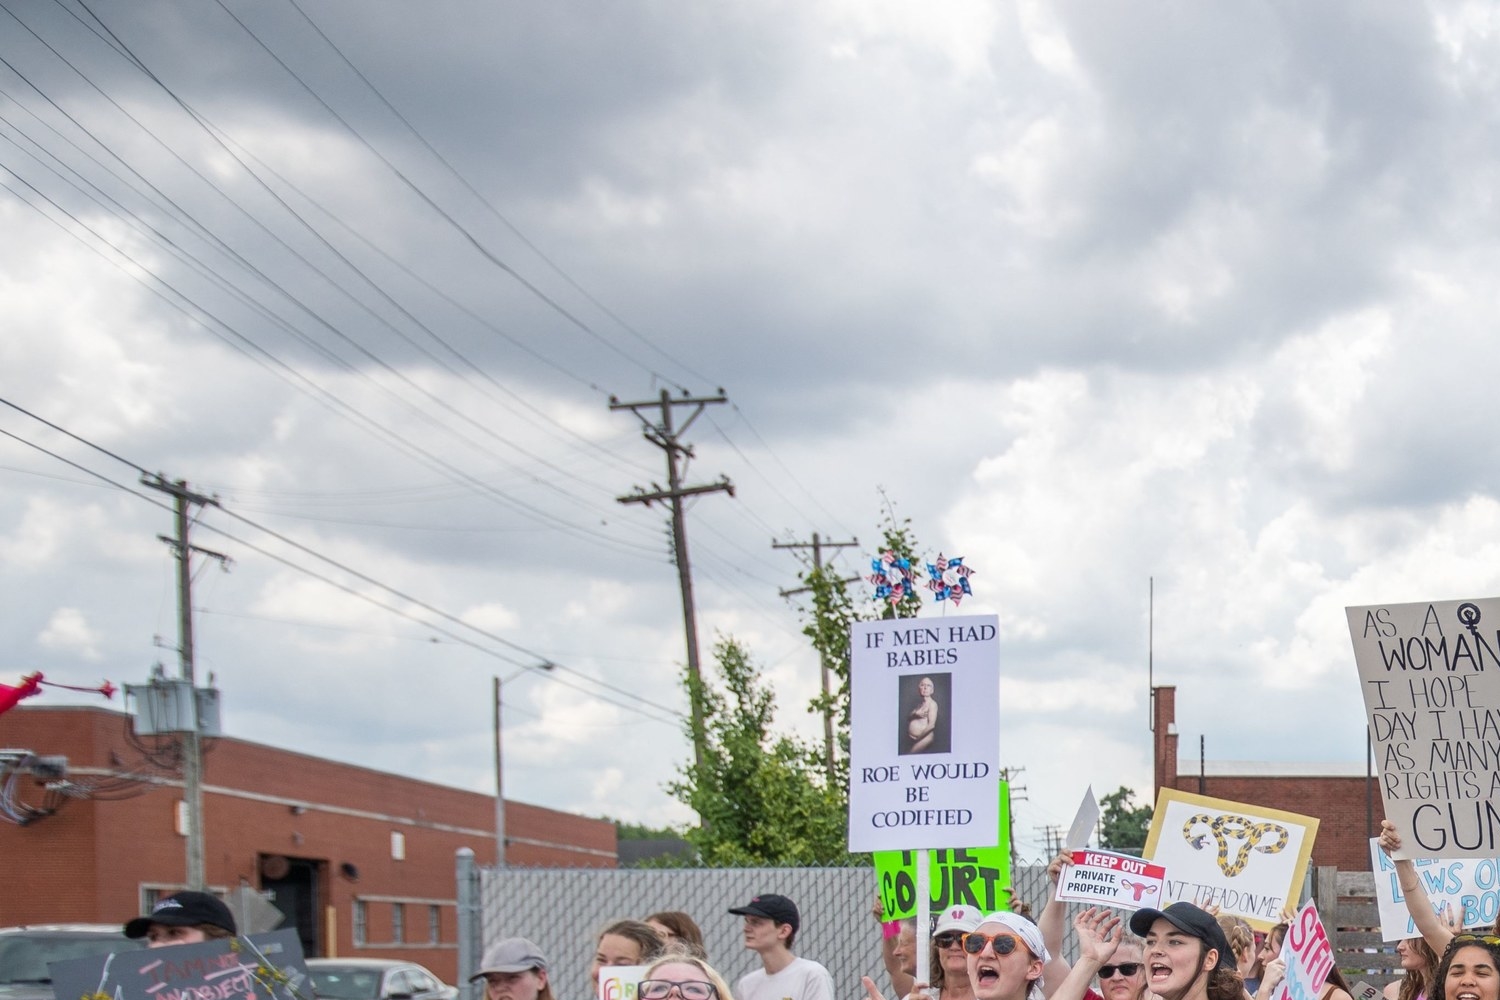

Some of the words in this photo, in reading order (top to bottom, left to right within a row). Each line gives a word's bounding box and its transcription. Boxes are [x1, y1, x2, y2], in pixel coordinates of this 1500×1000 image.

[1364, 608, 1397, 639] AS
[1422, 604, 1443, 637] A
[865, 631, 885, 649] IF
[892, 627, 941, 648] MEN
[948, 624, 996, 643] HAD
[886, 648, 958, 668] BABIES
[1368, 680, 1397, 710] I
[1409, 674, 1485, 709] HOPE
[1373, 711, 1417, 742] DAY
[1428, 710, 1449, 741] I
[1385, 742, 1416, 771] AS
[861, 765, 900, 784] ROE
[911, 762, 990, 781] WOULD
[905, 786, 930, 803] BE
[1384, 771, 1481, 800] RIGHTS
[872, 809, 973, 829] CODIFIED
[1084, 853, 1118, 869] KEEP
[1121, 859, 1147, 875] OUT
[1075, 869, 1116, 884] PRIVATE
[883, 864, 1000, 918] COURT
[1067, 882, 1119, 897] PROPERTY
[1256, 896, 1282, 919] ME
[1289, 906, 1335, 994] STFU
